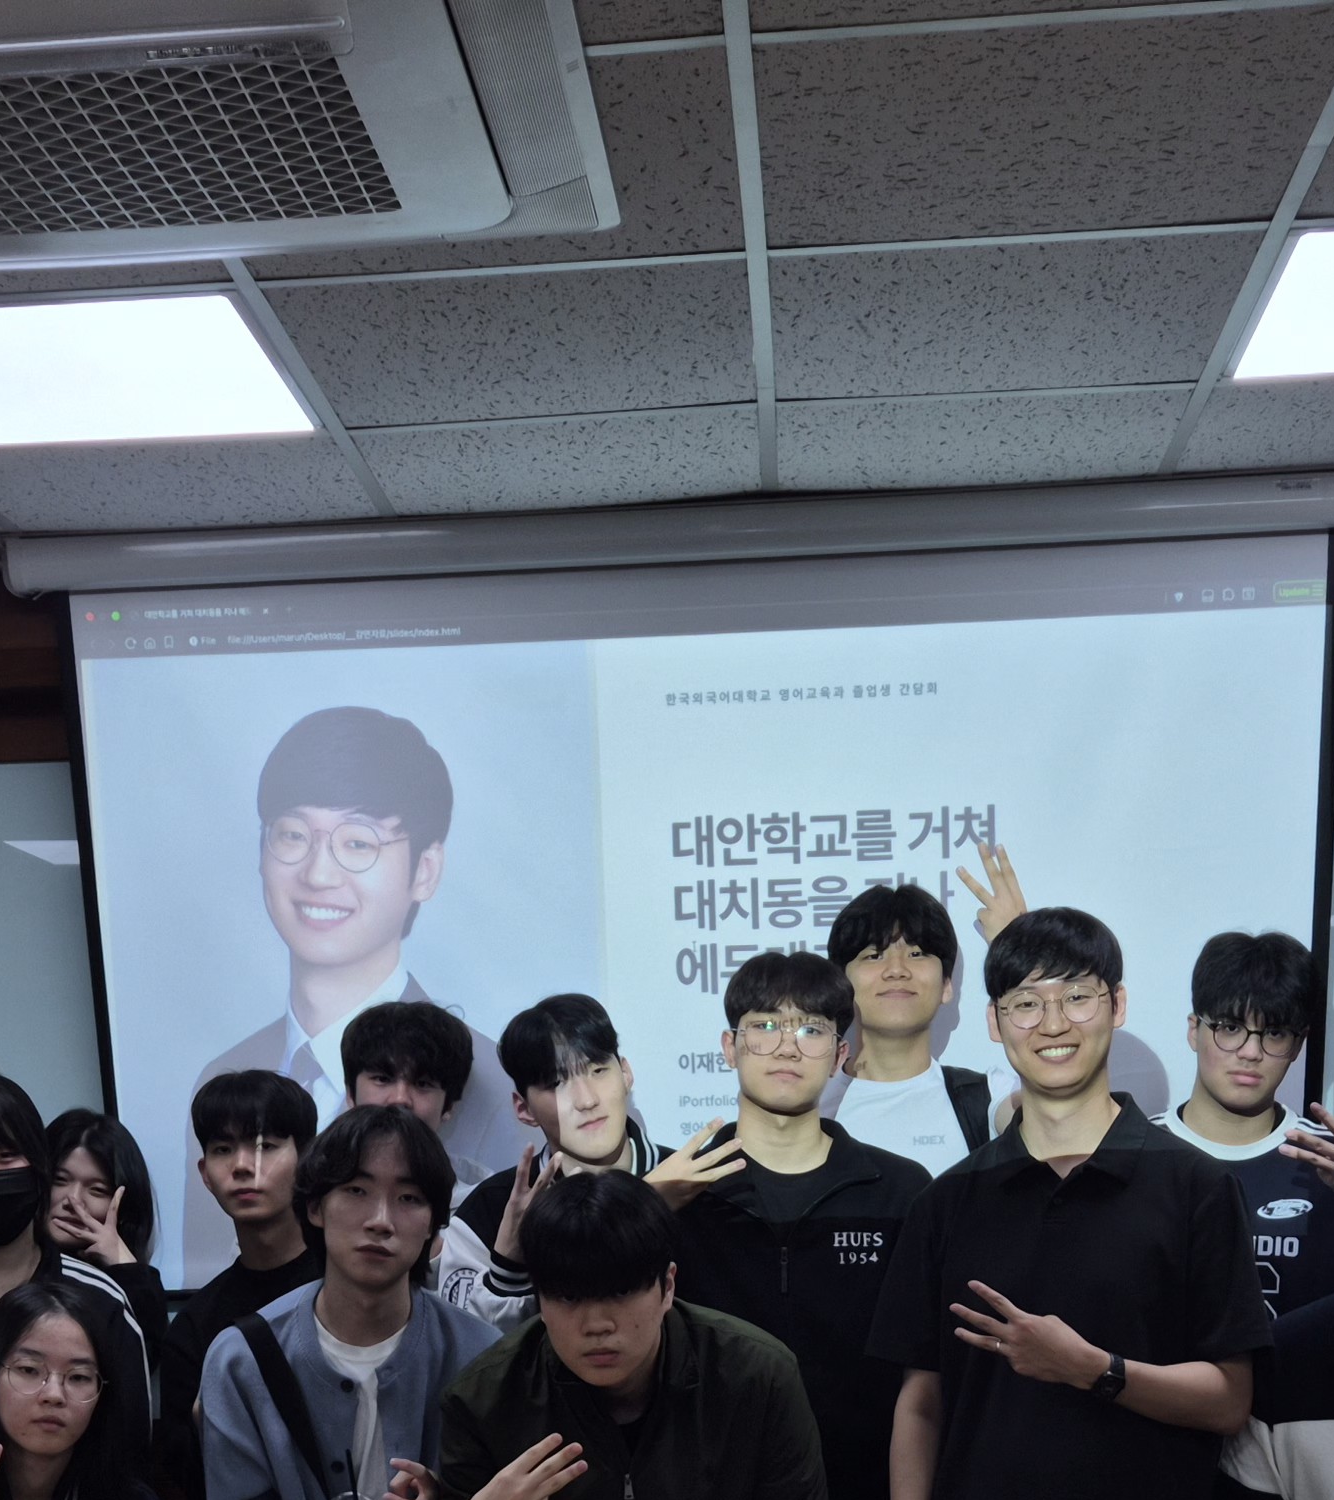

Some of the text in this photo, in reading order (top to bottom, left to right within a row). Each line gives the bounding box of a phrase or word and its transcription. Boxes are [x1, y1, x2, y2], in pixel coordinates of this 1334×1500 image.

[665, 681, 938, 706] 한국외국어대학교 영어교육과 졸업생 간담회
[672, 804, 996, 867] 대안학교를 거쳐
[674, 875, 853, 931] 대치동을
[679, 1095, 738, 1107] iPortfolio
[832, 1232, 883, 1247] HUFS
[1252, 1235, 1300, 1257] DIO
[839, 1251, 879, 1265] 1954
